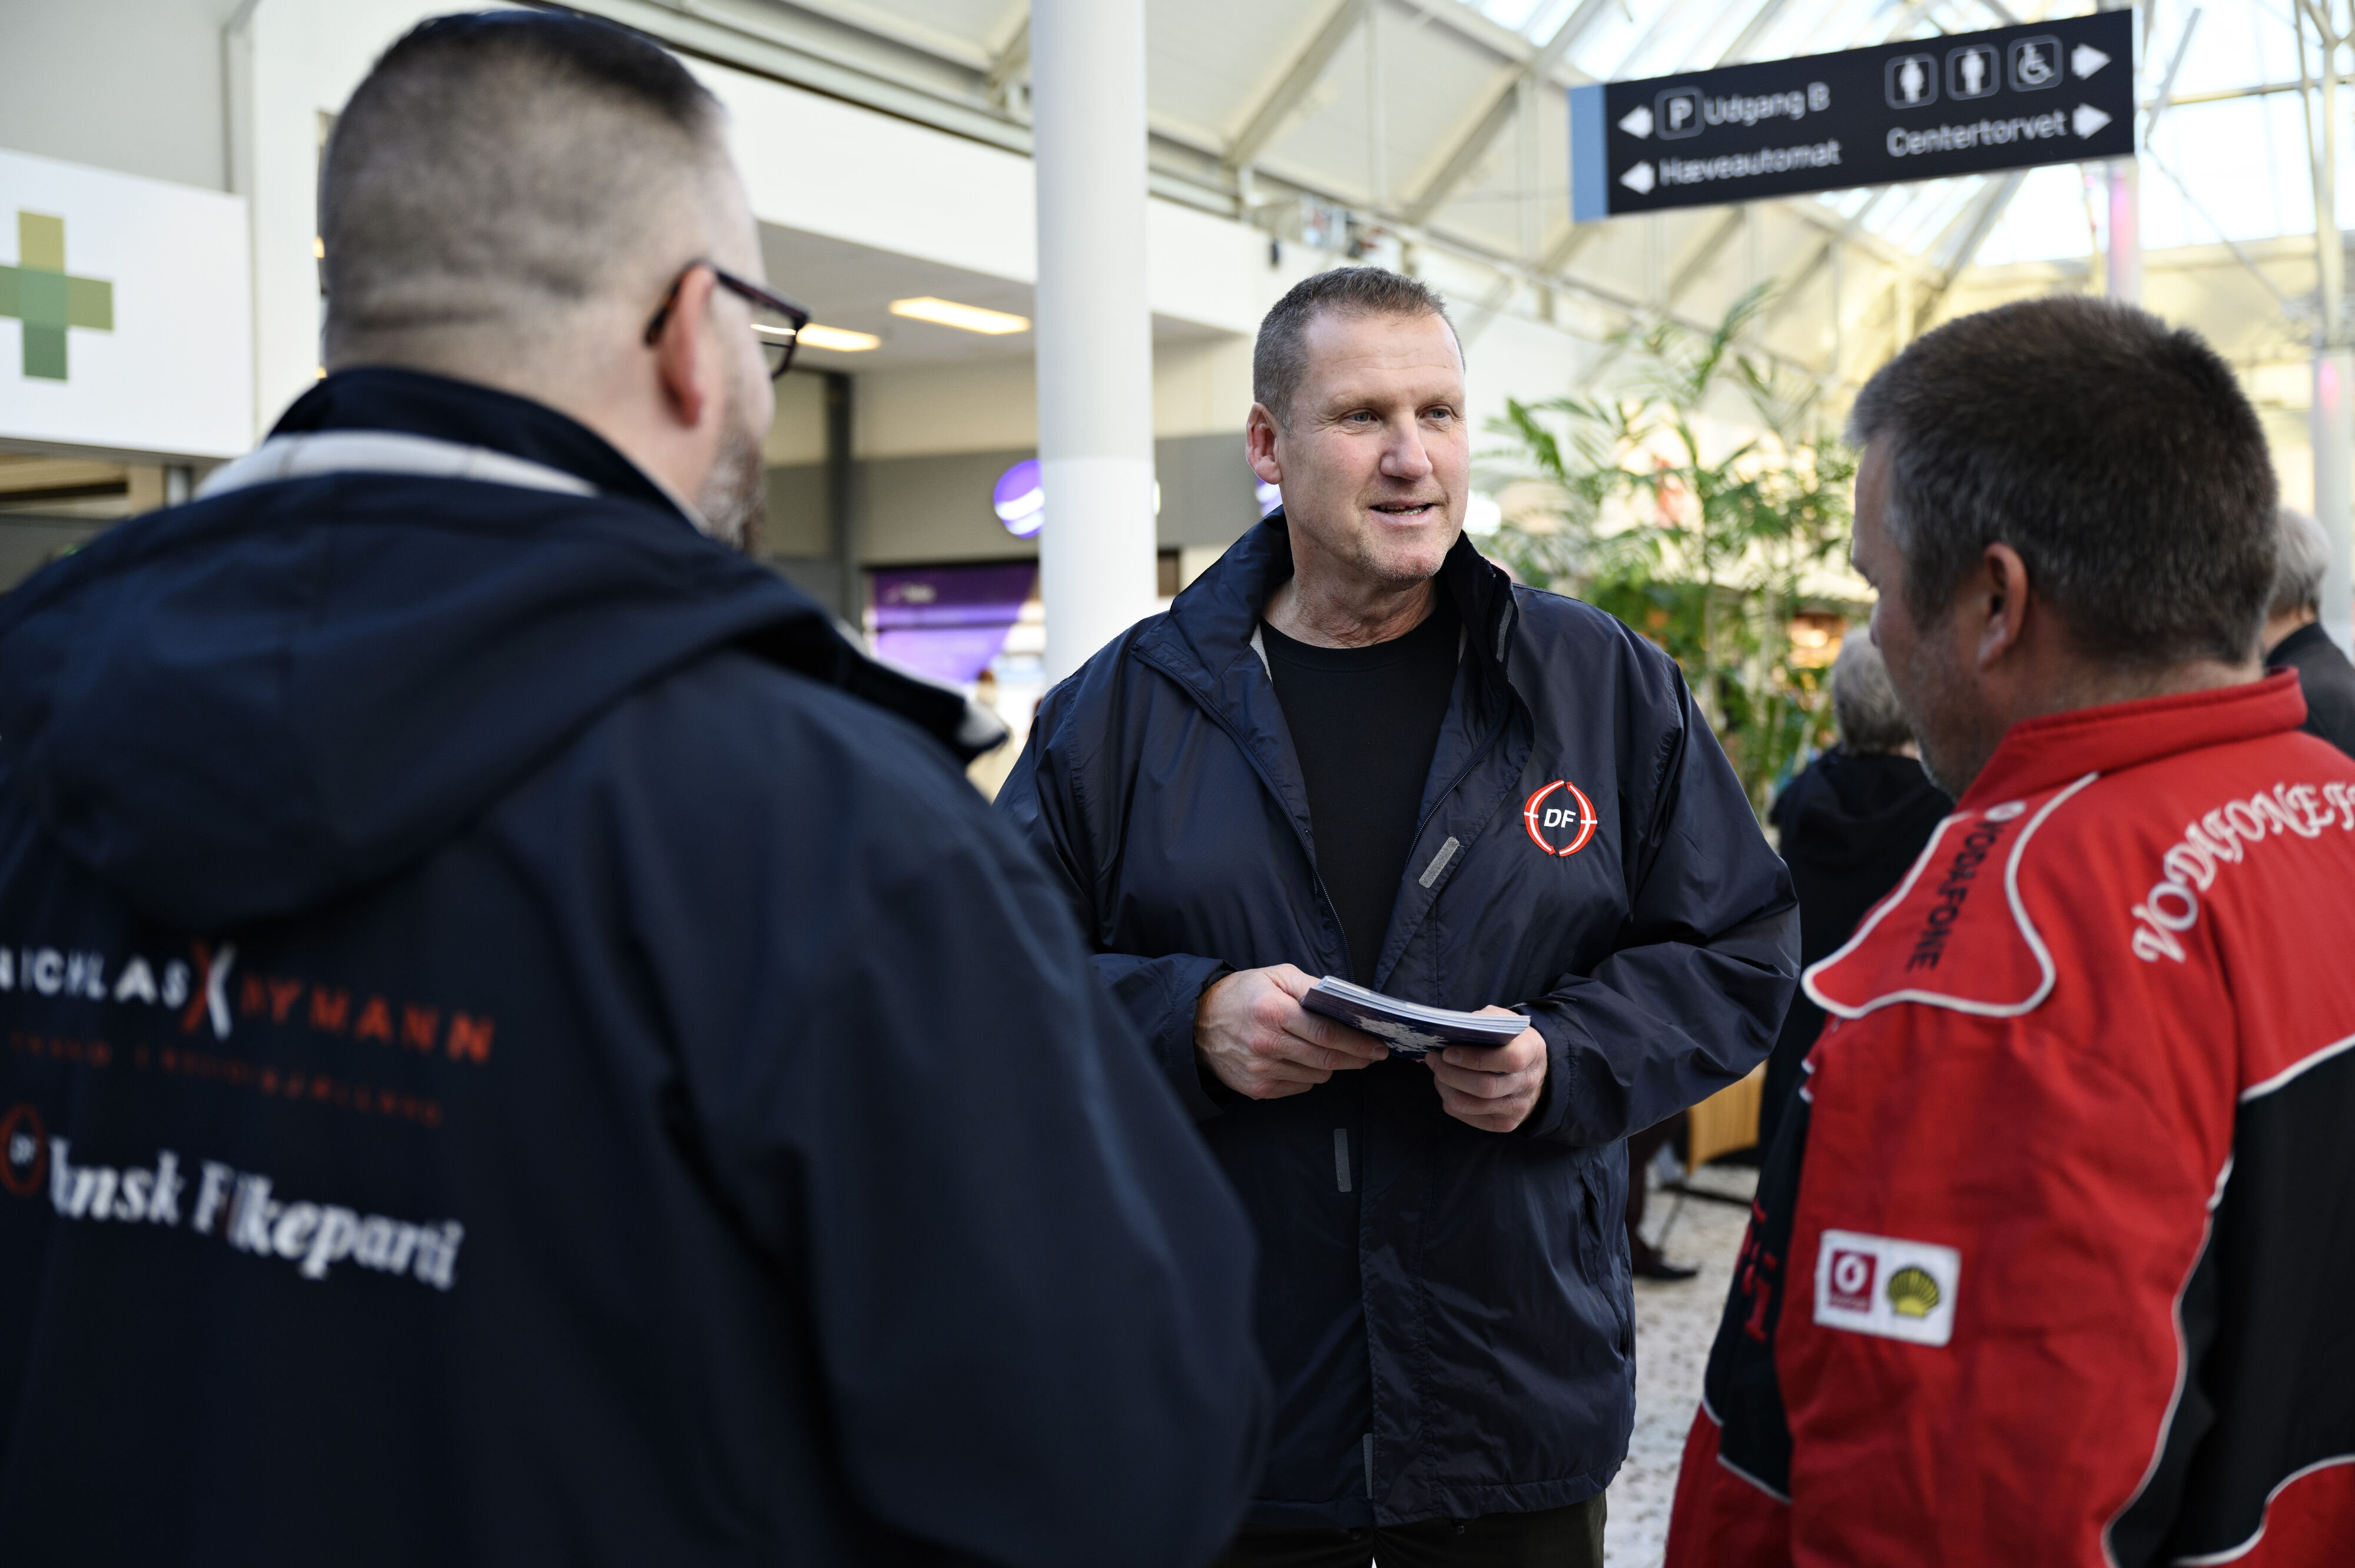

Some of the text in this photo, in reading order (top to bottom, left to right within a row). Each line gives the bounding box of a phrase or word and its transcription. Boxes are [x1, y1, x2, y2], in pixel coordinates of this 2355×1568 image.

[1669, 81, 1831, 131] P Udgang B
[1886, 107, 2069, 158] Centertorvet
[1659, 137, 1843, 187] Hæveautomat
[1544, 808, 1576, 828] DF
[193, 1154, 465, 1293] Flkeparti
